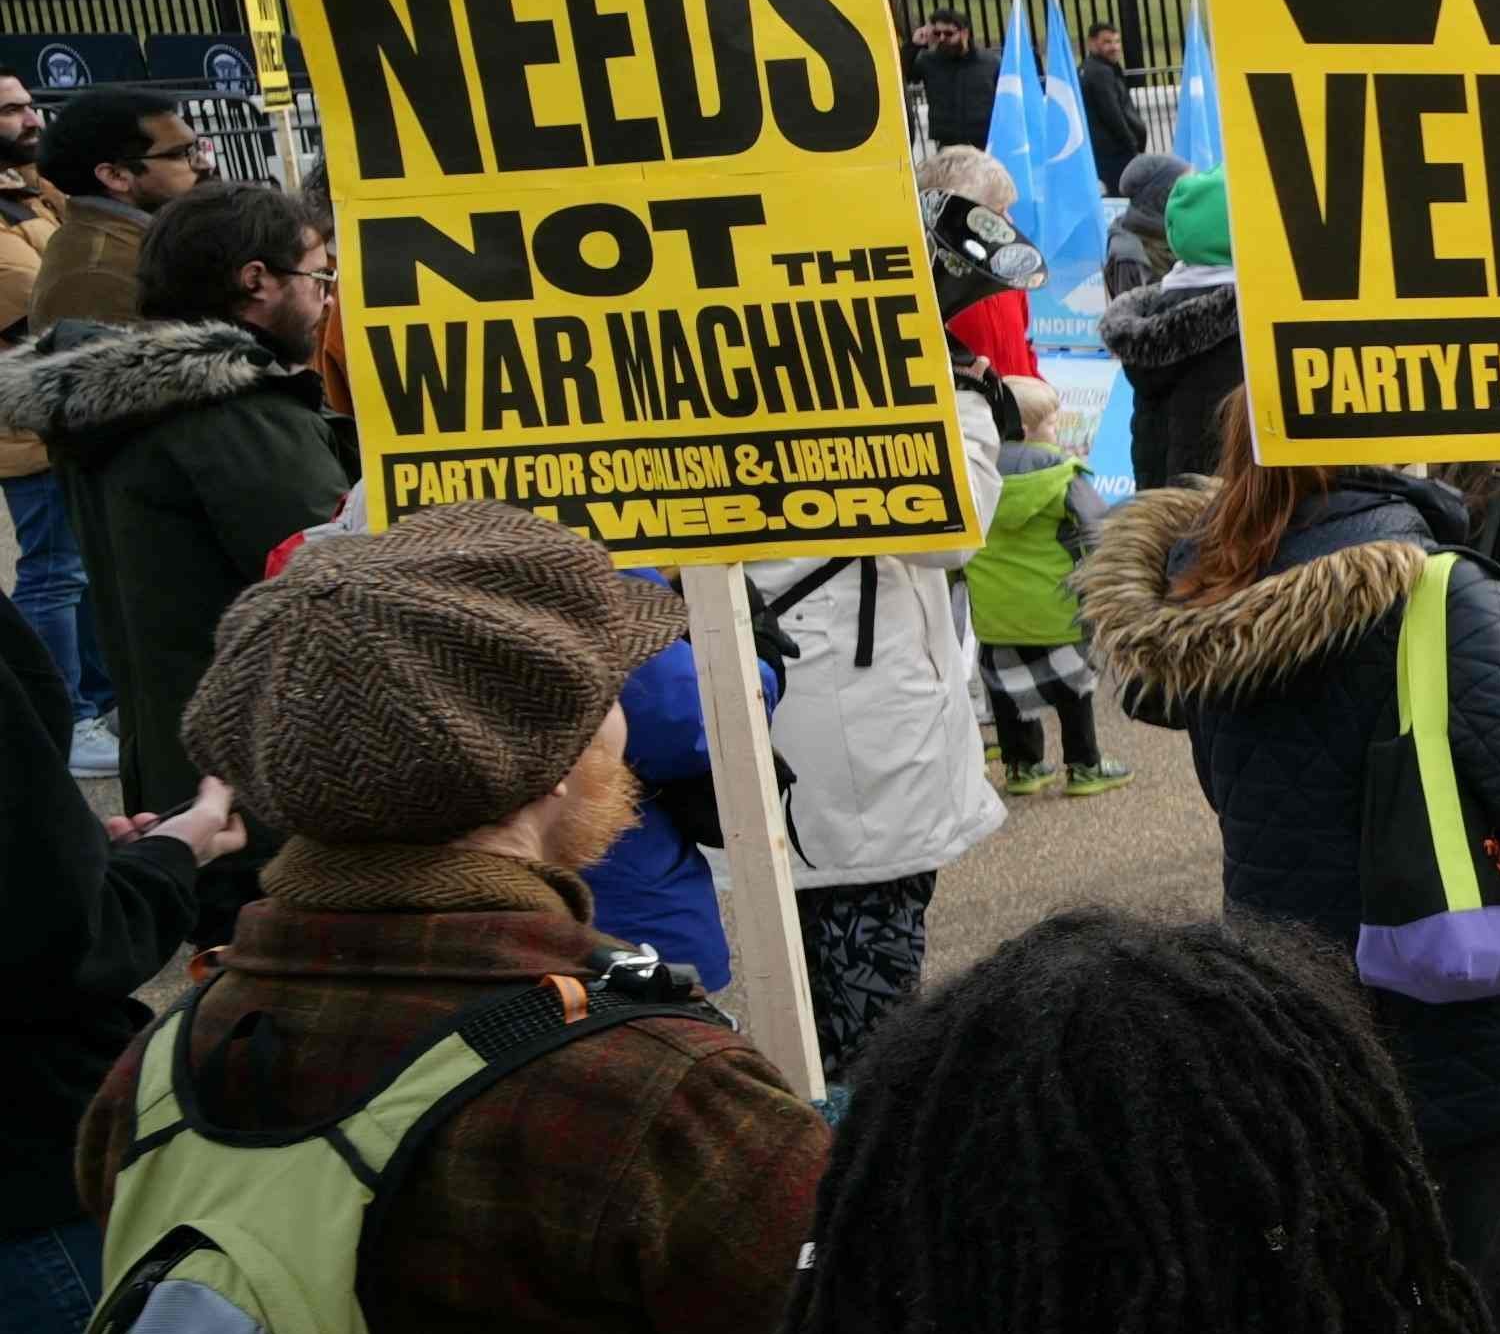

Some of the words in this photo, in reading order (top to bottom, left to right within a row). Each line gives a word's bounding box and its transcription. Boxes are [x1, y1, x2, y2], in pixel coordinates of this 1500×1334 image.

[358, 194, 766, 308] NOT
[772, 246, 913, 286] THE
[365, 316, 604, 435] WAR
[606, 295, 937, 421] MACHINE
[1293, 344, 1460, 414] PARTY
[394, 458, 508, 507] PARTY
[514, 454, 586, 498] FOR
[589, 446, 730, 493] SOCIALISM
[735, 445, 778, 485] &
[776, 433, 939, 482] LIBERATION
[398, 485, 947, 539] LWEB.ORG
